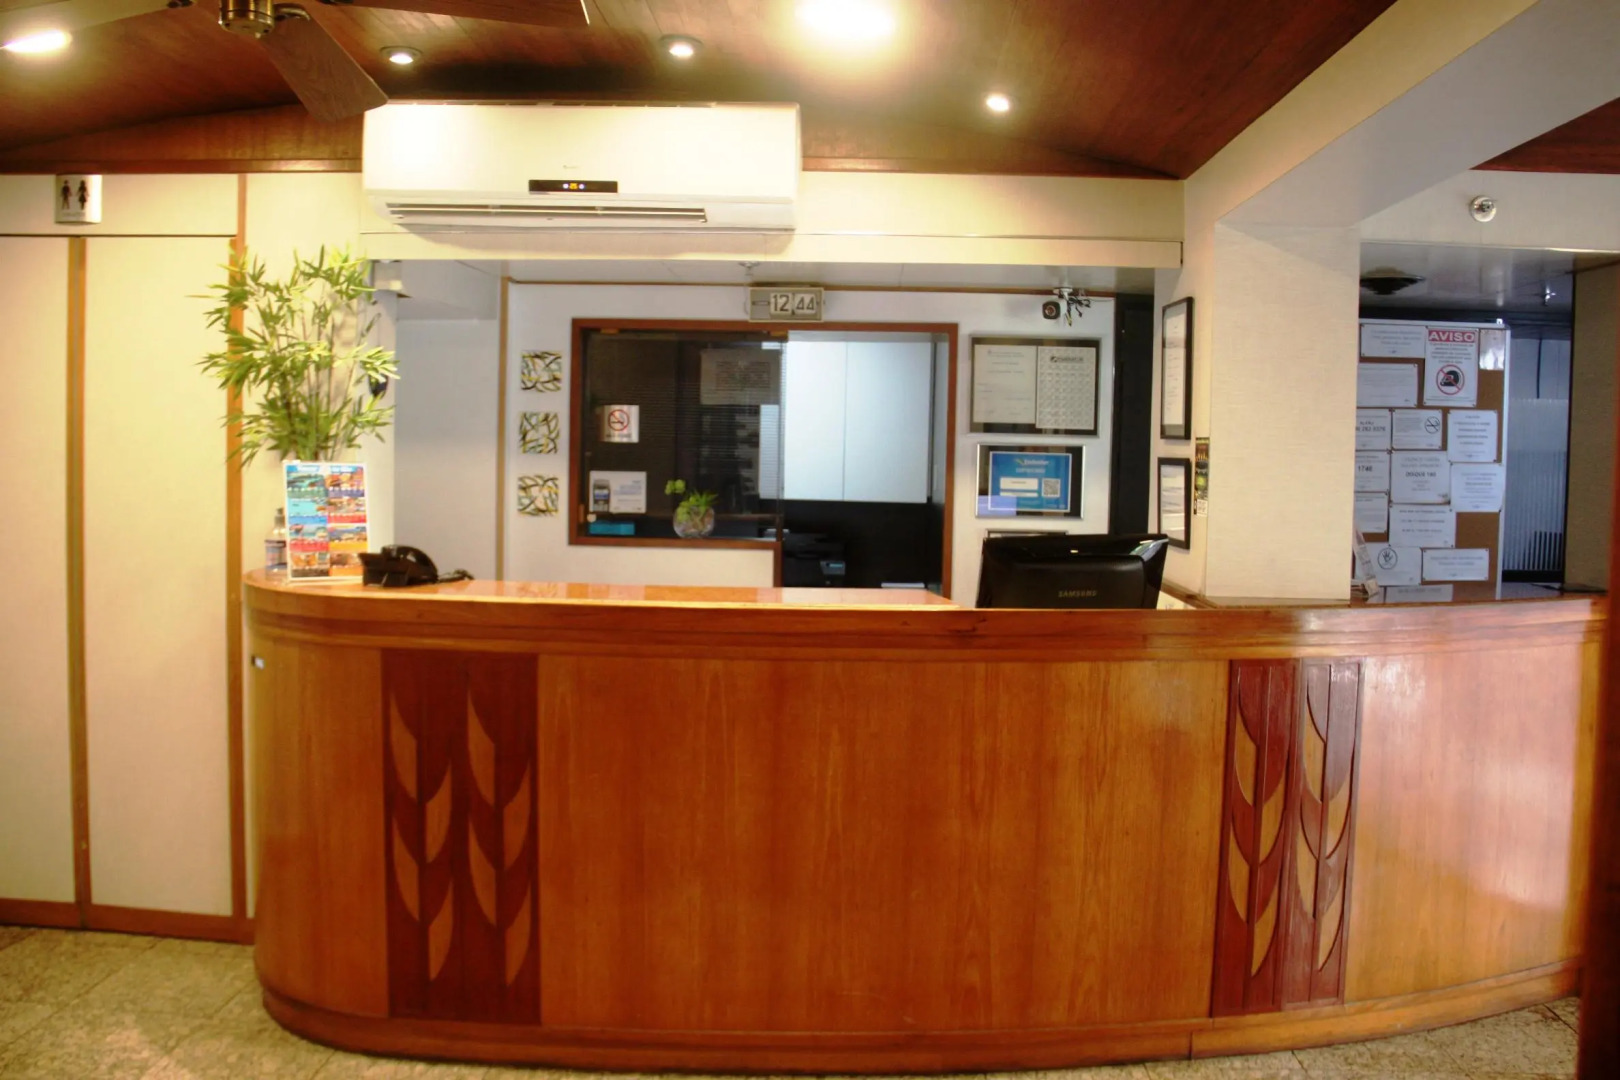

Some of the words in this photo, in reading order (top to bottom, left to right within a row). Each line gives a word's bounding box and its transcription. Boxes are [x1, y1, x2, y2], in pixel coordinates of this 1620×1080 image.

[773, 293, 790, 312] 12
[796, 295, 815, 311] 44
[1429, 331, 1475, 342] AVISO
[1058, 589, 1097, 598] SAMSUNG
